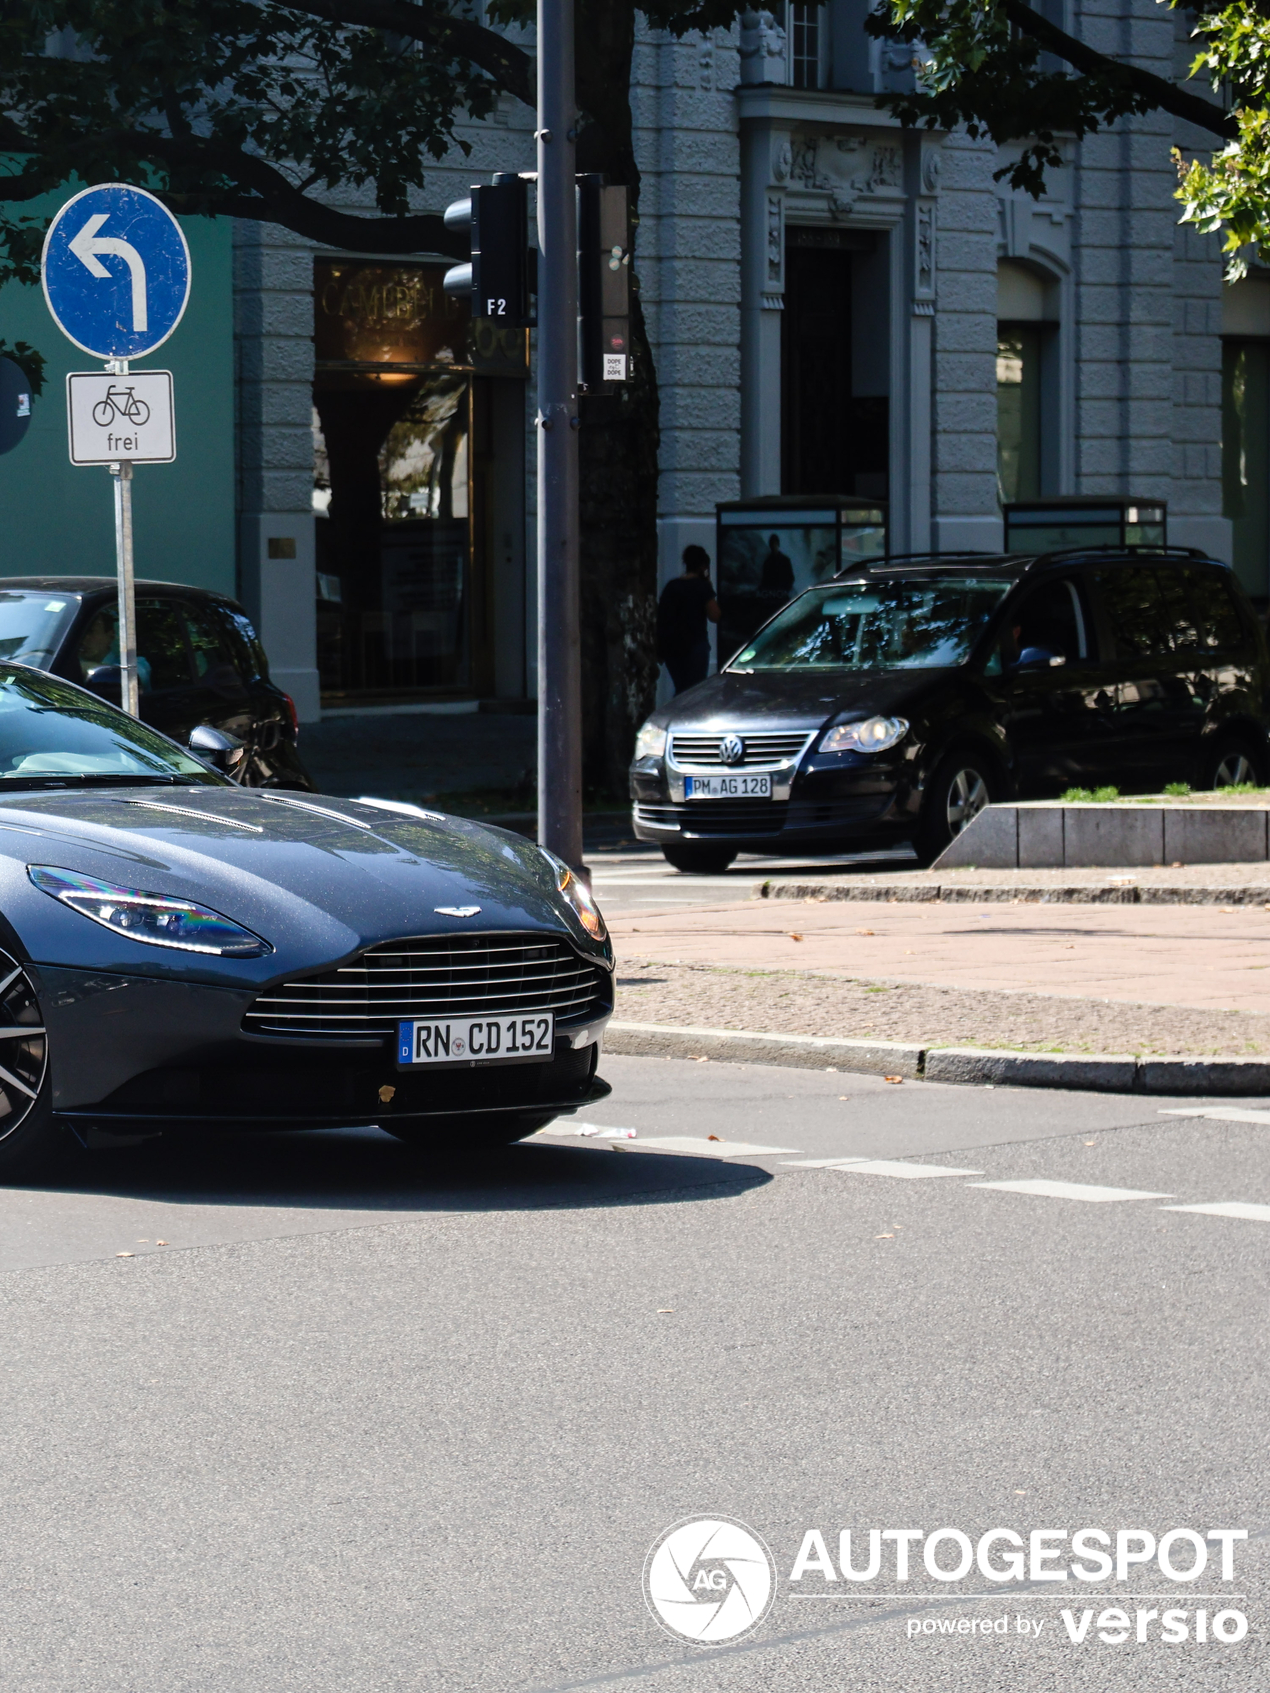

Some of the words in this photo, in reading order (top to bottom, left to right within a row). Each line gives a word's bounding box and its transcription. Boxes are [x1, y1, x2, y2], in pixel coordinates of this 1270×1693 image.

[487, 298, 506, 316] F2
[107, 432, 139, 451] frei
[693, 779, 711, 795] PM
[720, 778, 738, 795] AG
[741, 777, 769, 795] 128
[416, 1024, 451, 1058] RN
[468, 1021, 501, 1055] CD
[506, 1018, 550, 1053] 152
[402, 1046, 409, 1057] D
